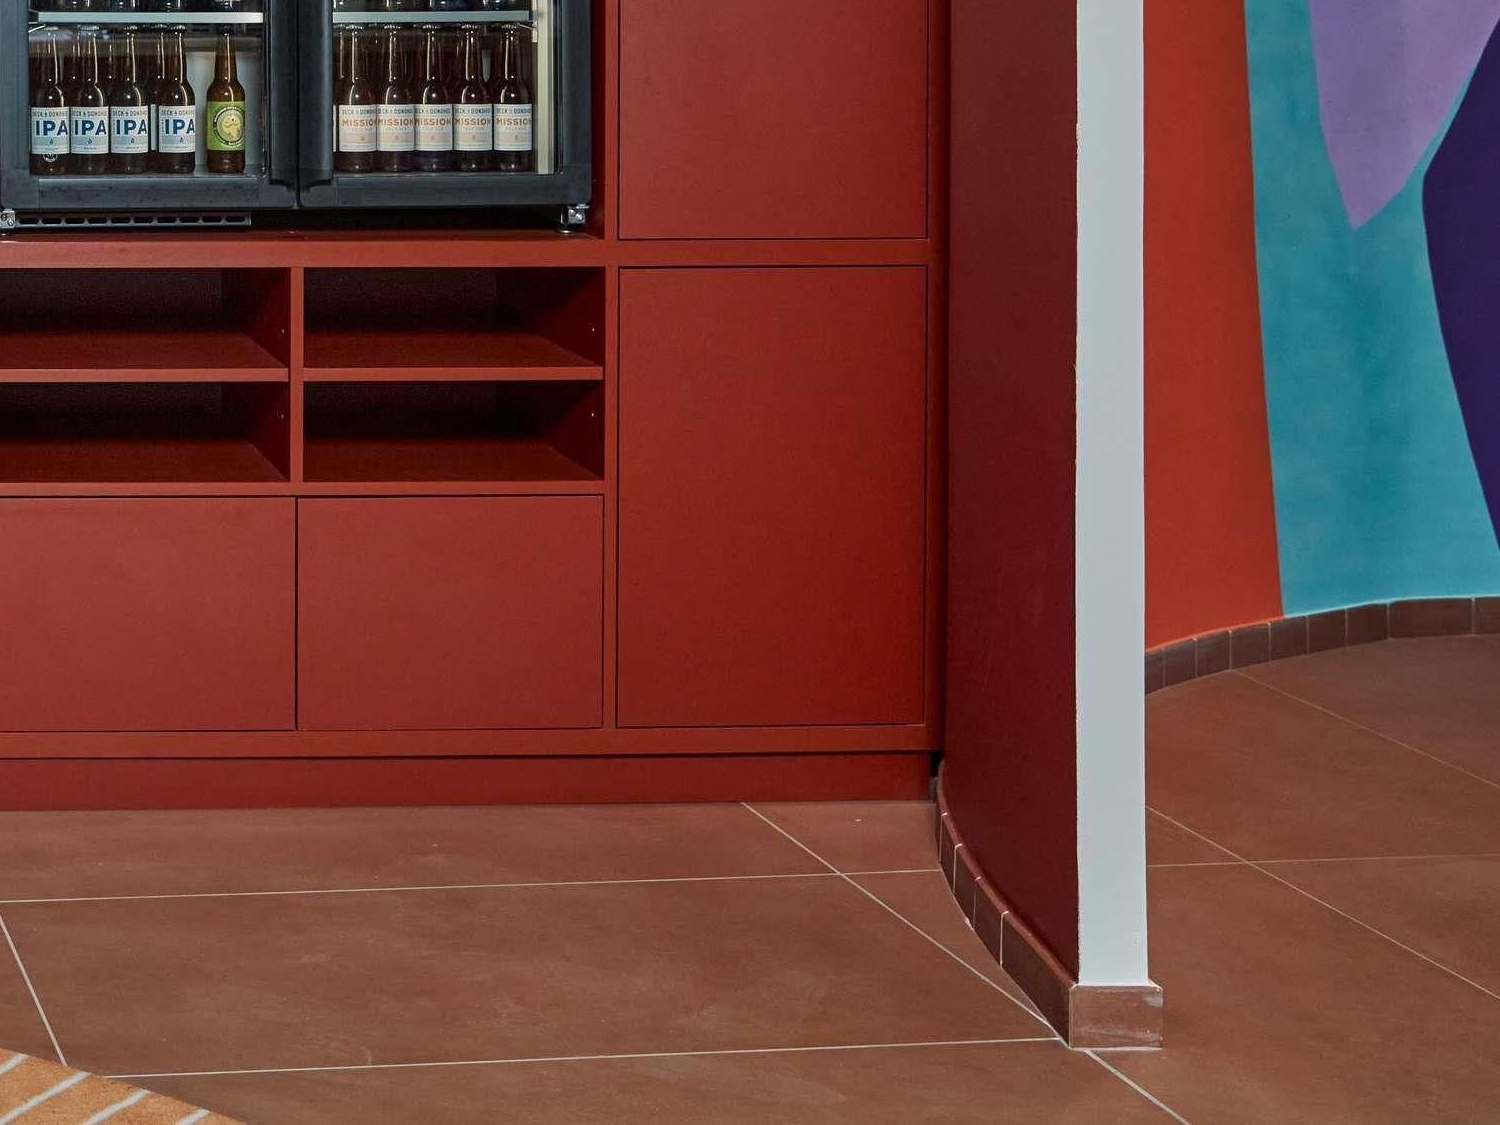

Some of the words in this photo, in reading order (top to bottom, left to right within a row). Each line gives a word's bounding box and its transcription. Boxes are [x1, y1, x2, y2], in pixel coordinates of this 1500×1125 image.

[36, 119, 68, 136] IPA
[75, 119, 107, 135] IPA
[116, 119, 147, 135] IPA
[165, 119, 195, 135] IPA
